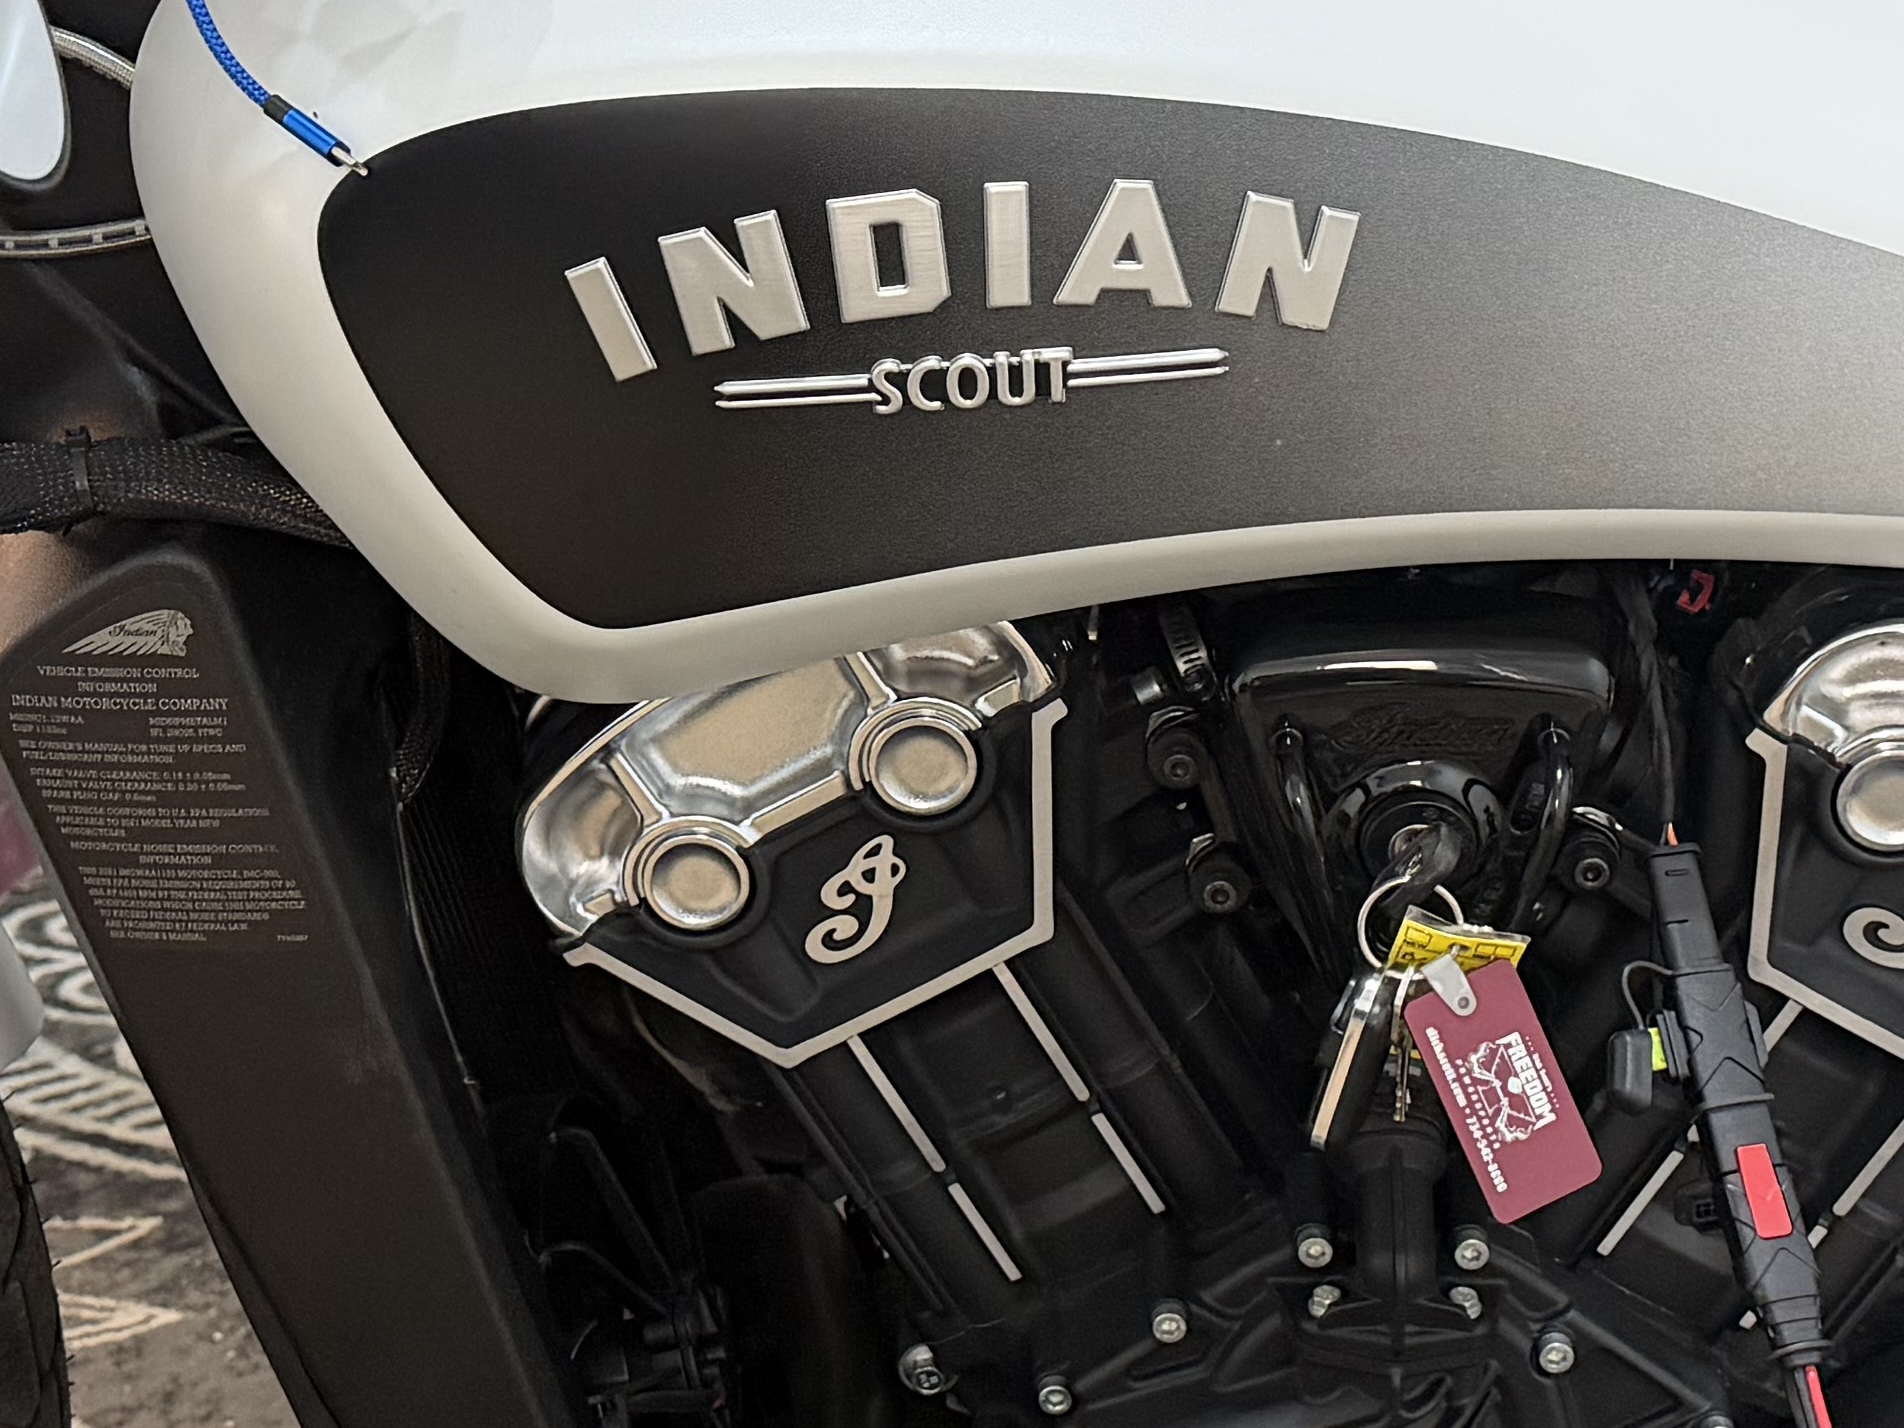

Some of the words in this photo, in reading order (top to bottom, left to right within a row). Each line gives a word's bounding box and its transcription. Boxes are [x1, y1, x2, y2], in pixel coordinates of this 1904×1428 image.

[564, 177, 1363, 383] INDIAN
[871, 346, 1075, 415] SCOUT
[108, 623, 158, 637] Indian
[37, 665, 86, 676] VEHICLE
[87, 667, 142, 678] EMISSION
[143, 668, 200, 678] CONTROL
[77, 682, 157, 693] INFORMATION
[11, 694, 58, 708] INDIAN
[60, 696, 157, 710] MOTORCYCLE
[158, 697, 229, 710] COMPANY
[1496, 1031, 1557, 1131] FREEDOM
